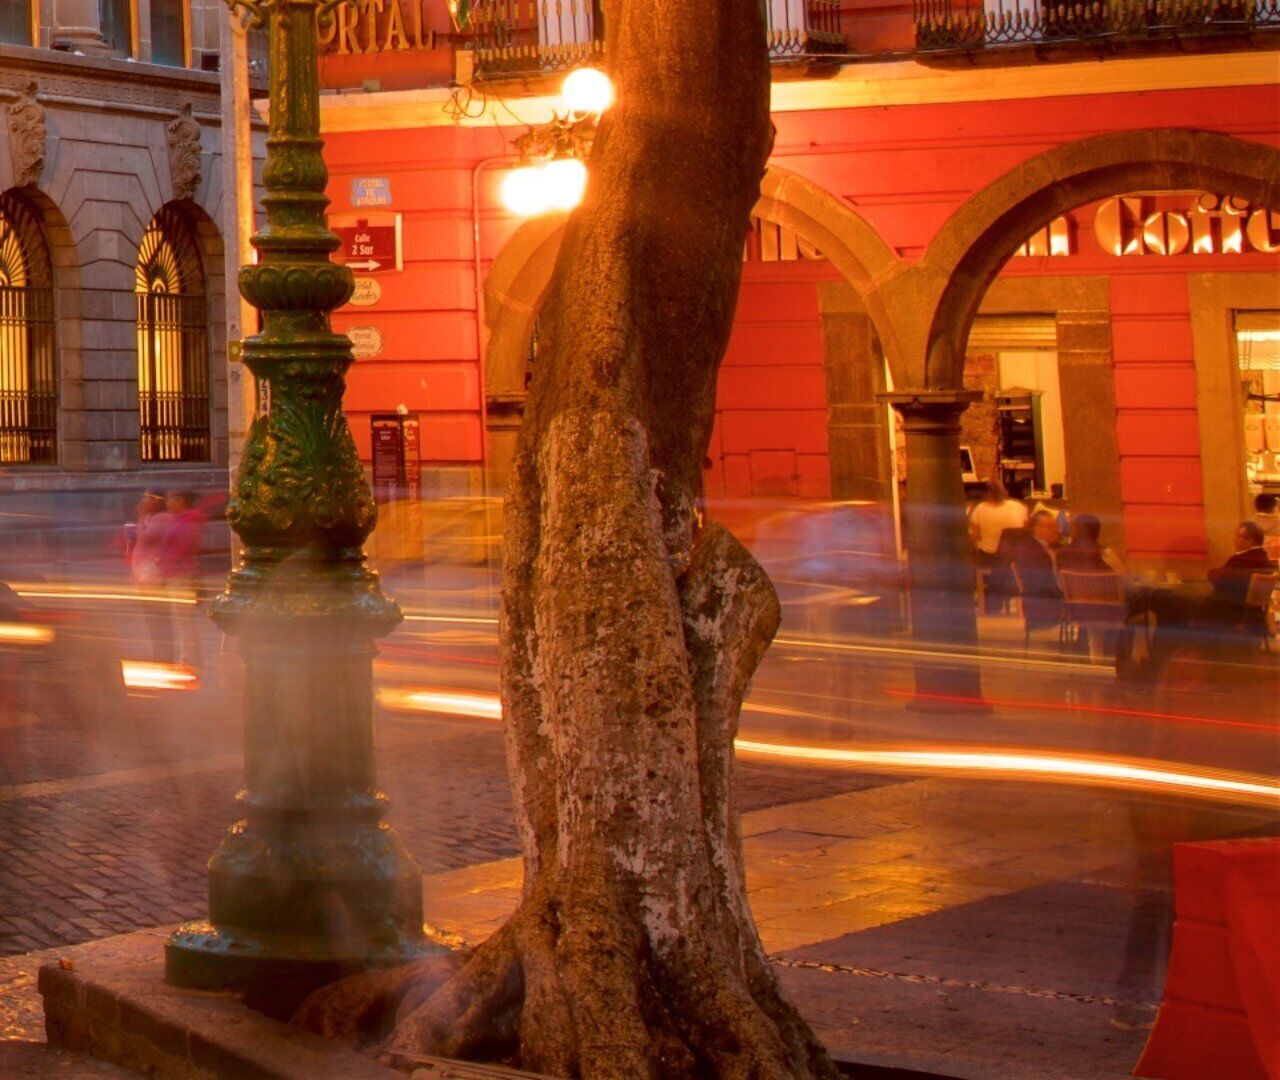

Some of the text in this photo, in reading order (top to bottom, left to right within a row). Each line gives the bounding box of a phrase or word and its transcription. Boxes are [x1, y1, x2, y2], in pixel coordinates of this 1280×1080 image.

[355, 233, 371, 243] Calle
[351, 245, 374, 256] 2 Sur
